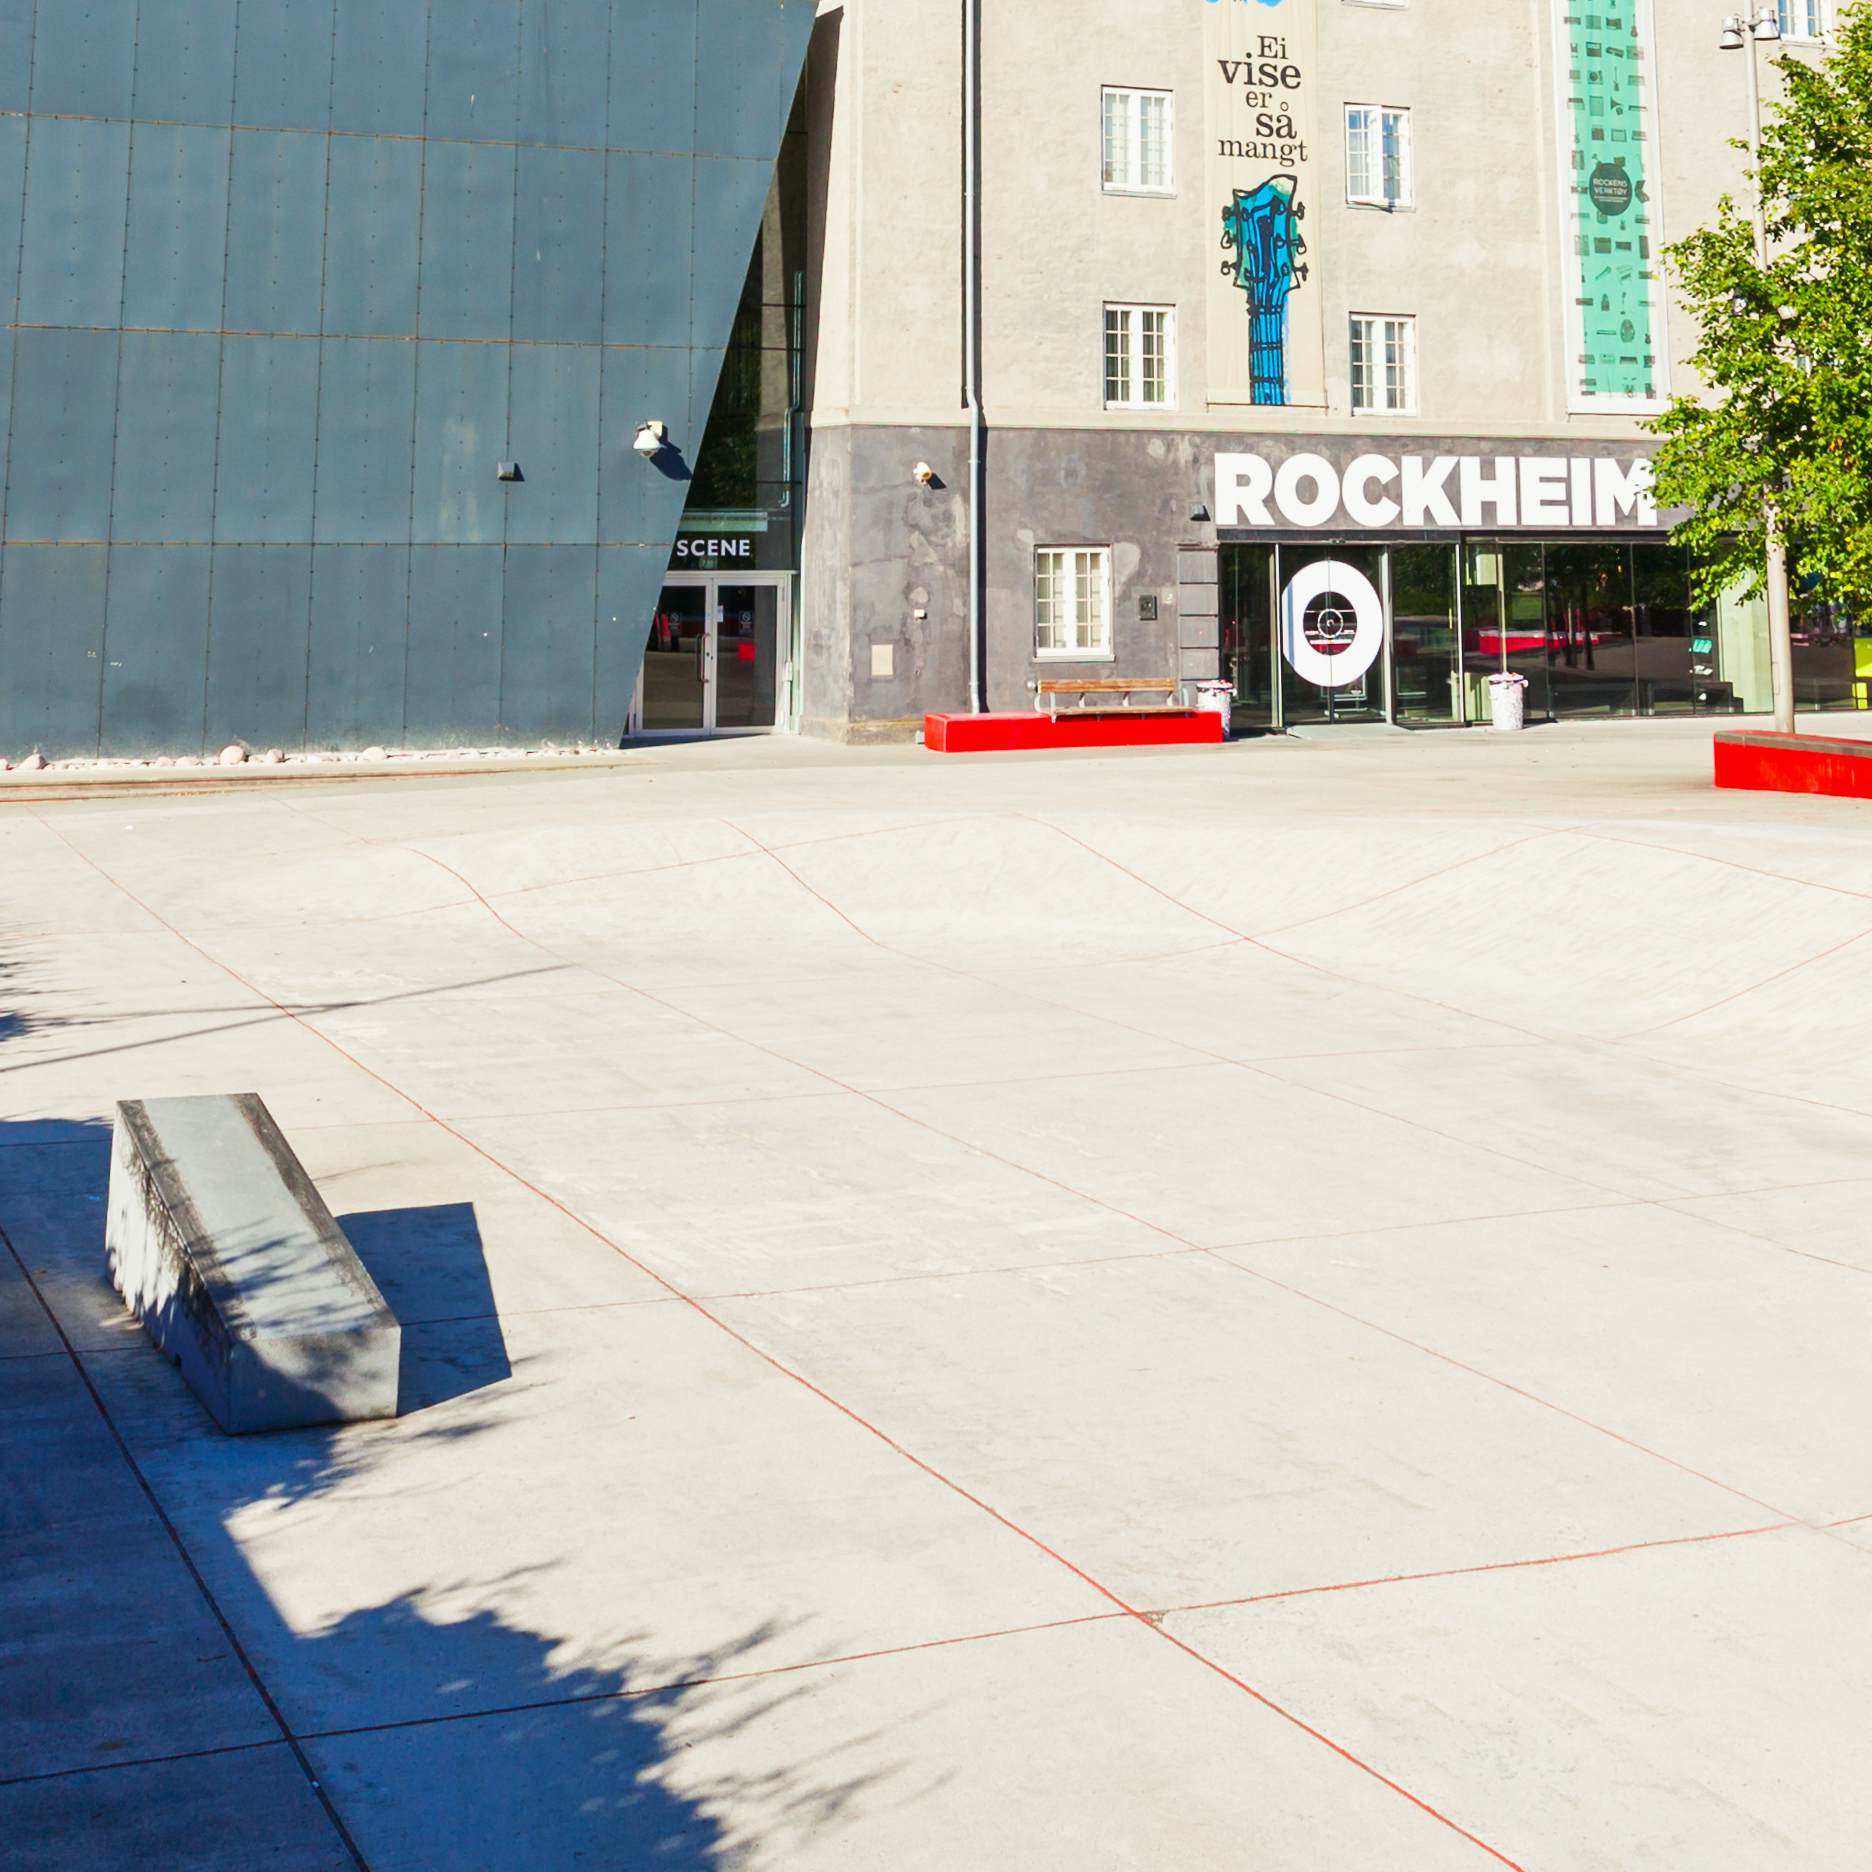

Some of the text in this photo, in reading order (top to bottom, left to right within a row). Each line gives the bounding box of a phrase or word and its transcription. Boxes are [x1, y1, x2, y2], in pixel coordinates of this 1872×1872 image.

[1257, 34, 1289, 59] Ei
[1217, 51, 1302, 90] vise
[1245, 90, 1273, 109] er
[1255, 100, 1298, 140] så
[1217, 138, 1309, 169] mangt
[1213, 451, 1659, 527] ROCKHEIM
[676, 538, 751, 558] SCENE
